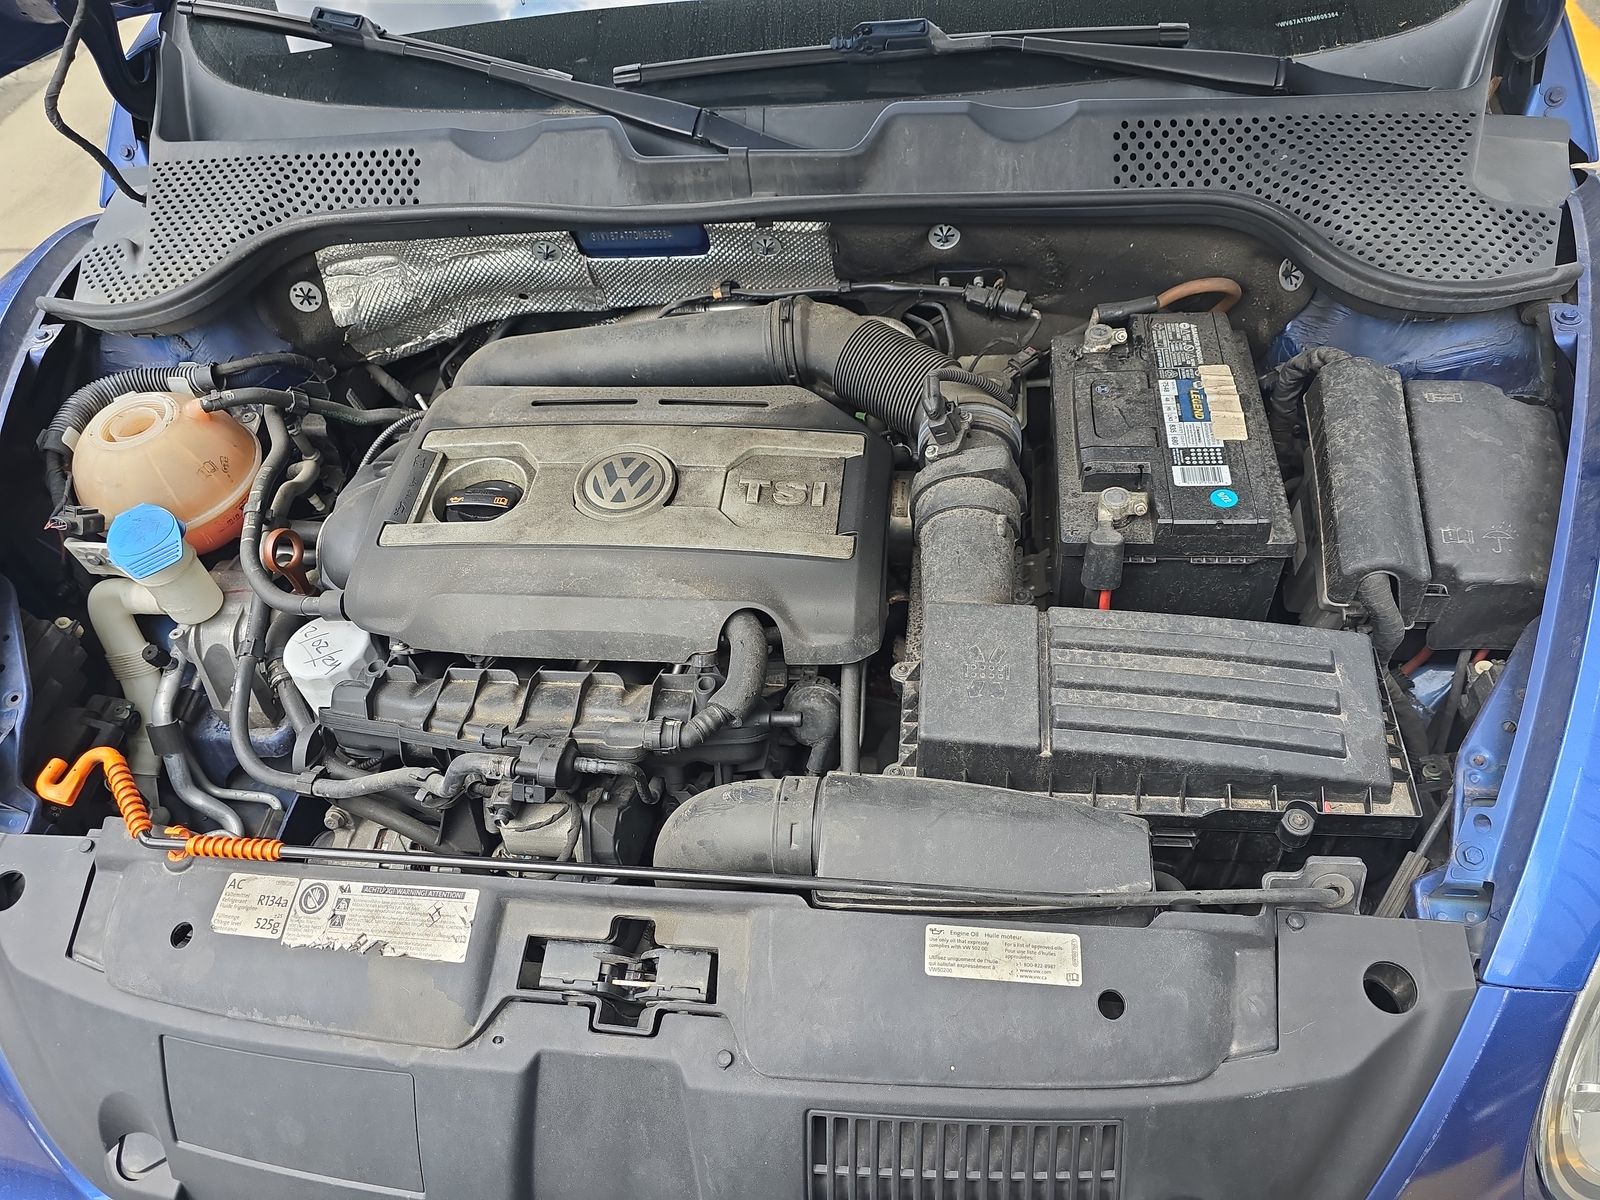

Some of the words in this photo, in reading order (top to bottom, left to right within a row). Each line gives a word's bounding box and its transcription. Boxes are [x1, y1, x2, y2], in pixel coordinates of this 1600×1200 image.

[1190, 390, 1204, 419] LEGEND
[583, 452, 665, 510] VW
[739, 480, 827, 506] TSI
[228, 879, 246, 889] AC
[257, 895, 288, 908] R134a
[254, 918, 280, 934] 525g
